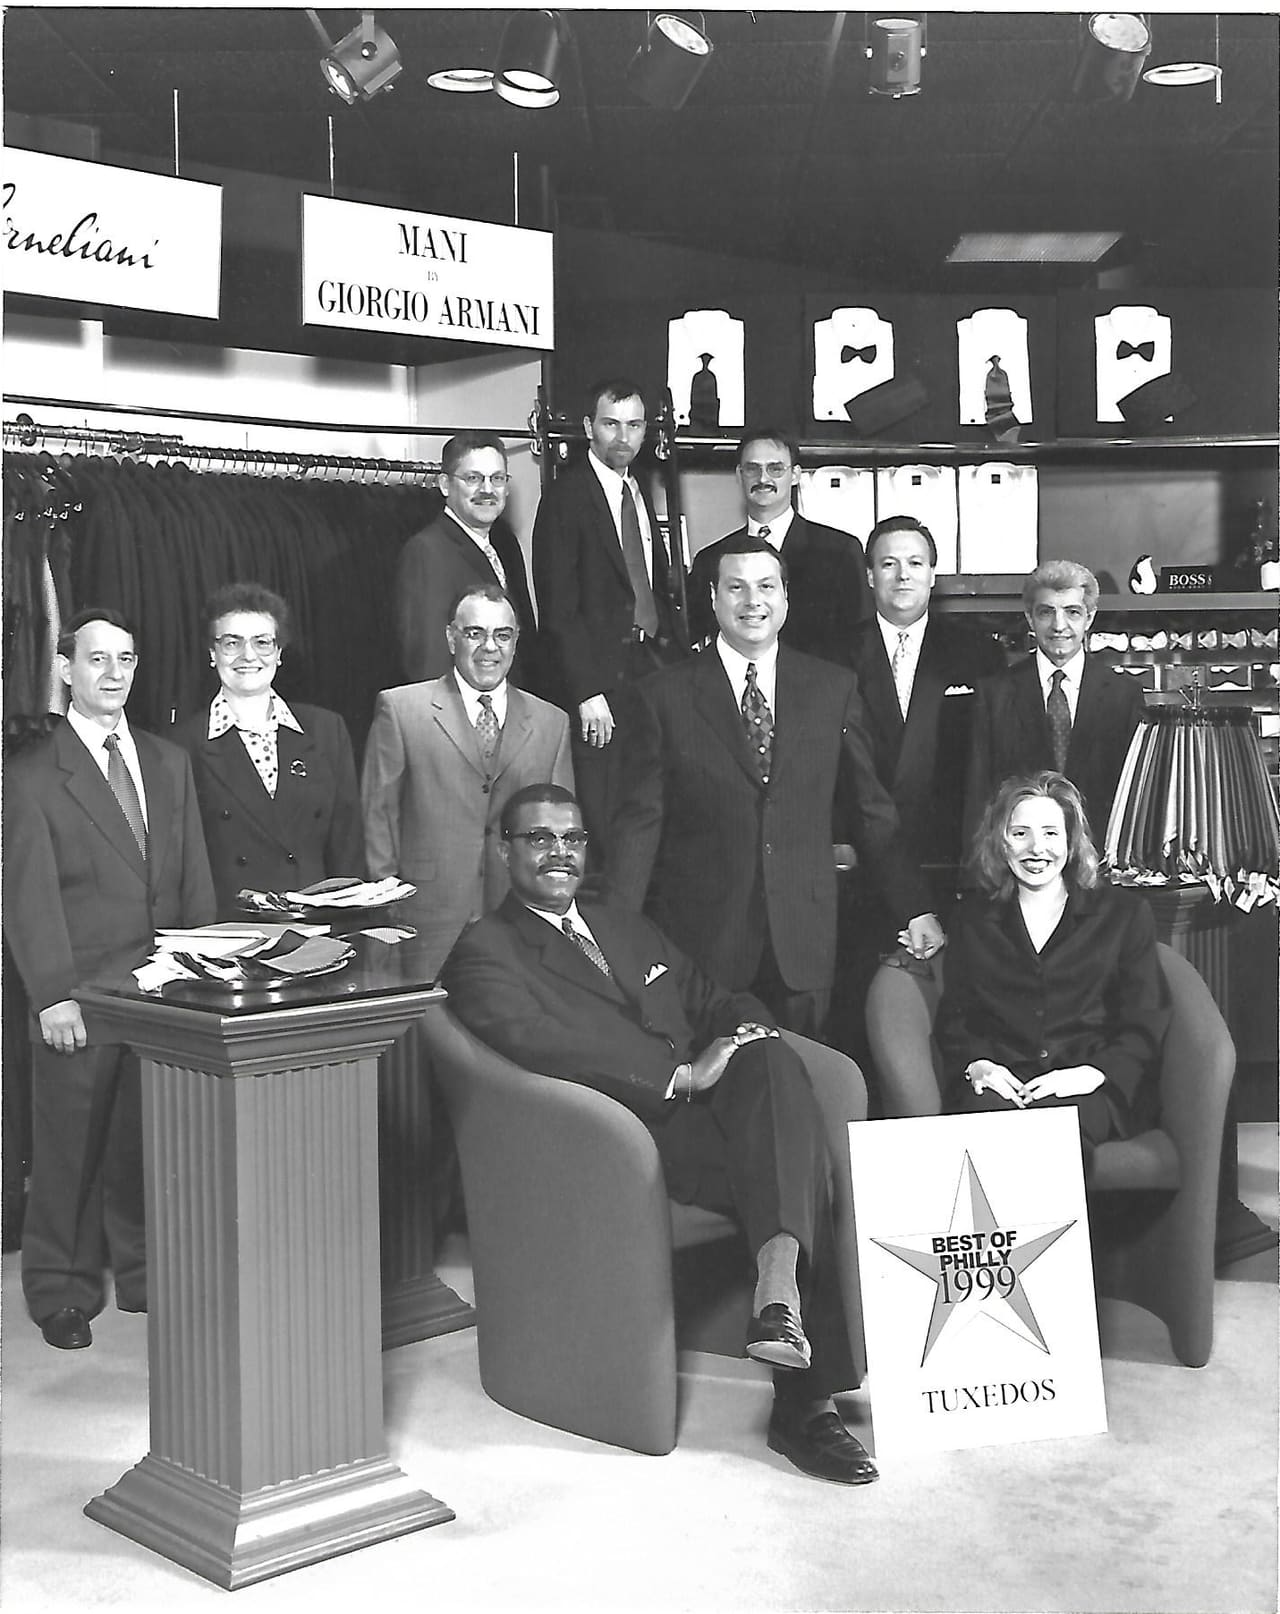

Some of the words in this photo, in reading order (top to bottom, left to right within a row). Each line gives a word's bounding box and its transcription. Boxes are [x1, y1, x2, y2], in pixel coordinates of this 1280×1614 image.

[3, 183, 159, 269] rneliani
[398, 223, 468, 263] MANI
[318, 280, 429, 322] GIORGIO
[438, 295, 540, 335] ARMANI
[1169, 574, 1206, 586] BOSS
[932, 1233, 986, 1254] BEST
[990, 1231, 1017, 1248] OF
[940, 1249, 1012, 1271] PHILLY
[939, 1265, 1016, 1304] 1999
[922, 1378, 1056, 1413] TUXEDOS
